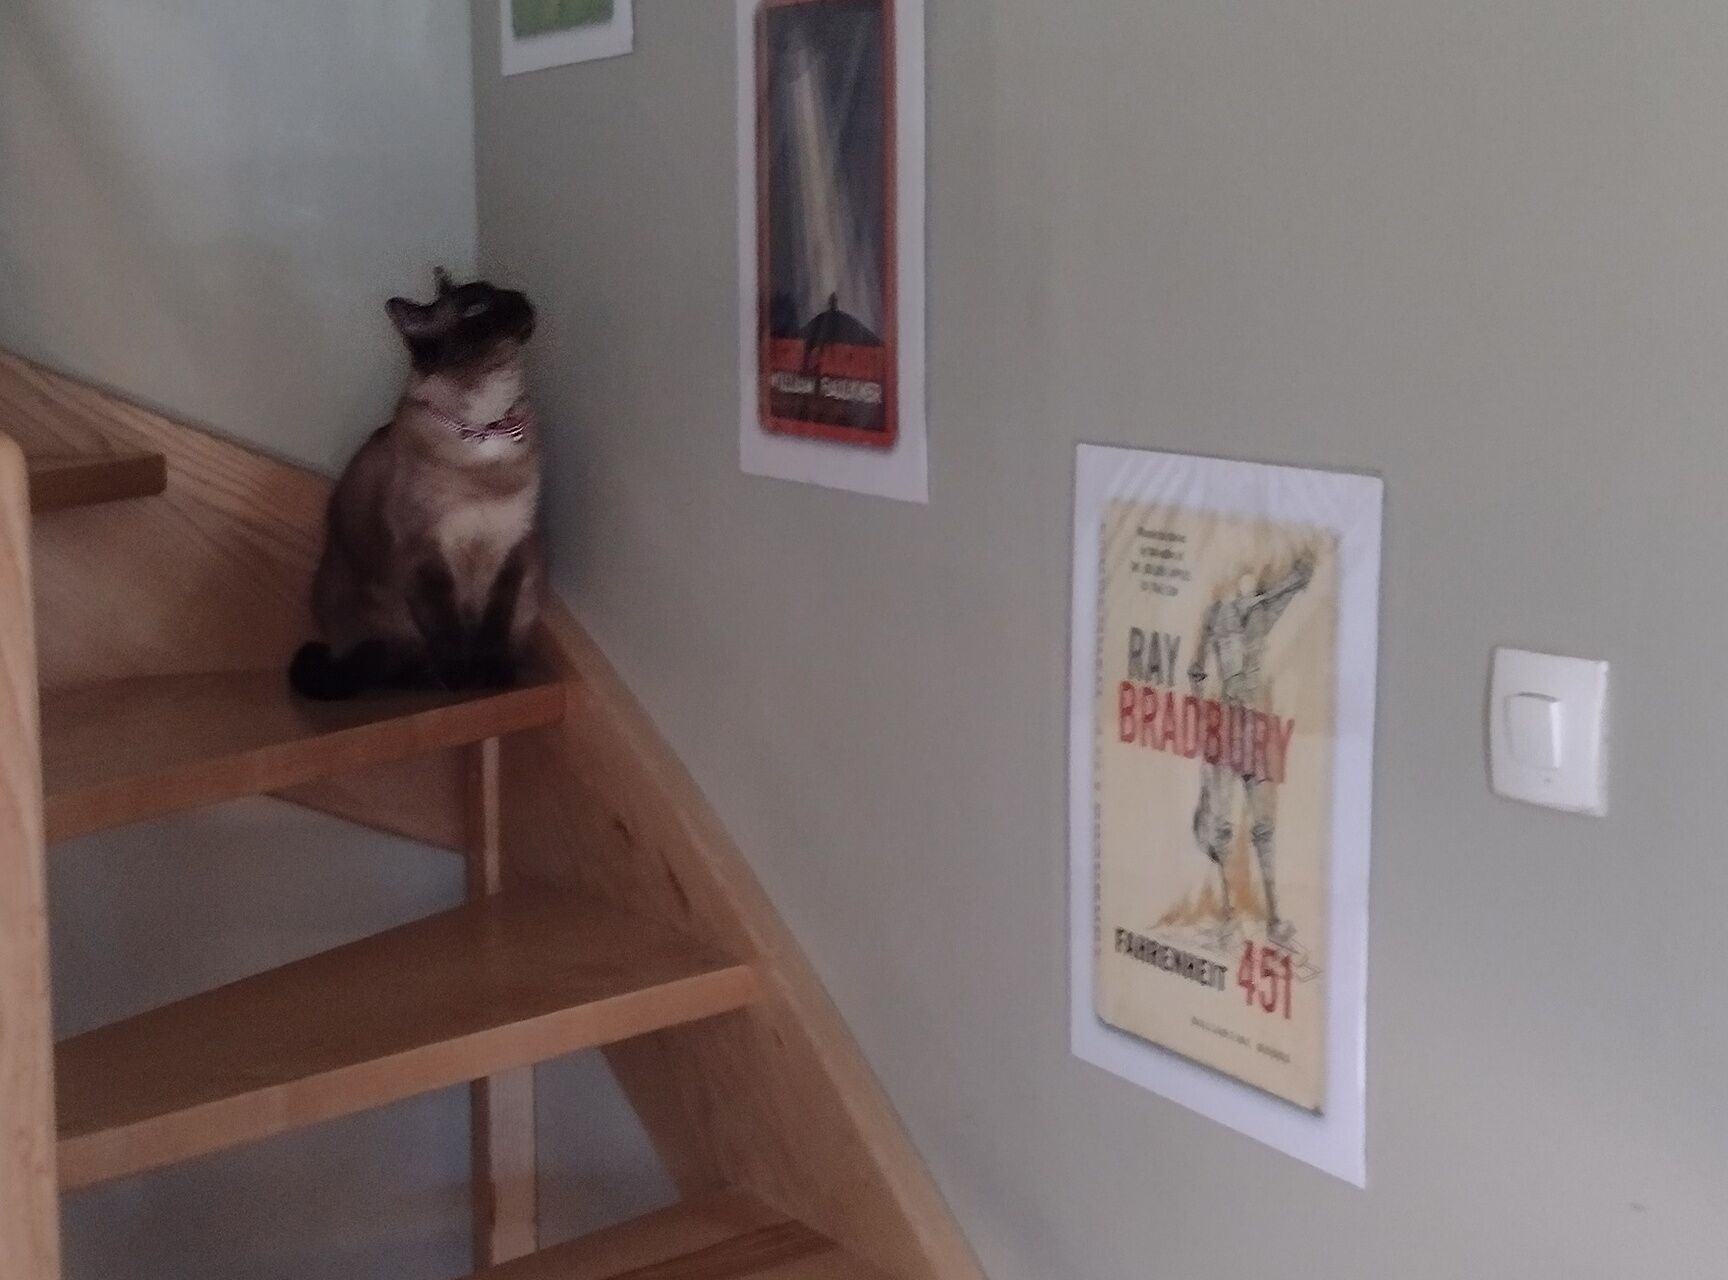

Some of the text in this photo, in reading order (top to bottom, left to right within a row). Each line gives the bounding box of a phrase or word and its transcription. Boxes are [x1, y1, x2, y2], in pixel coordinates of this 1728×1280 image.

[1127, 626, 1180, 687] RAY
[1117, 680, 1295, 784] BRADBURY
[1114, 926, 1293, 1020] FAHRENHEIT 451
